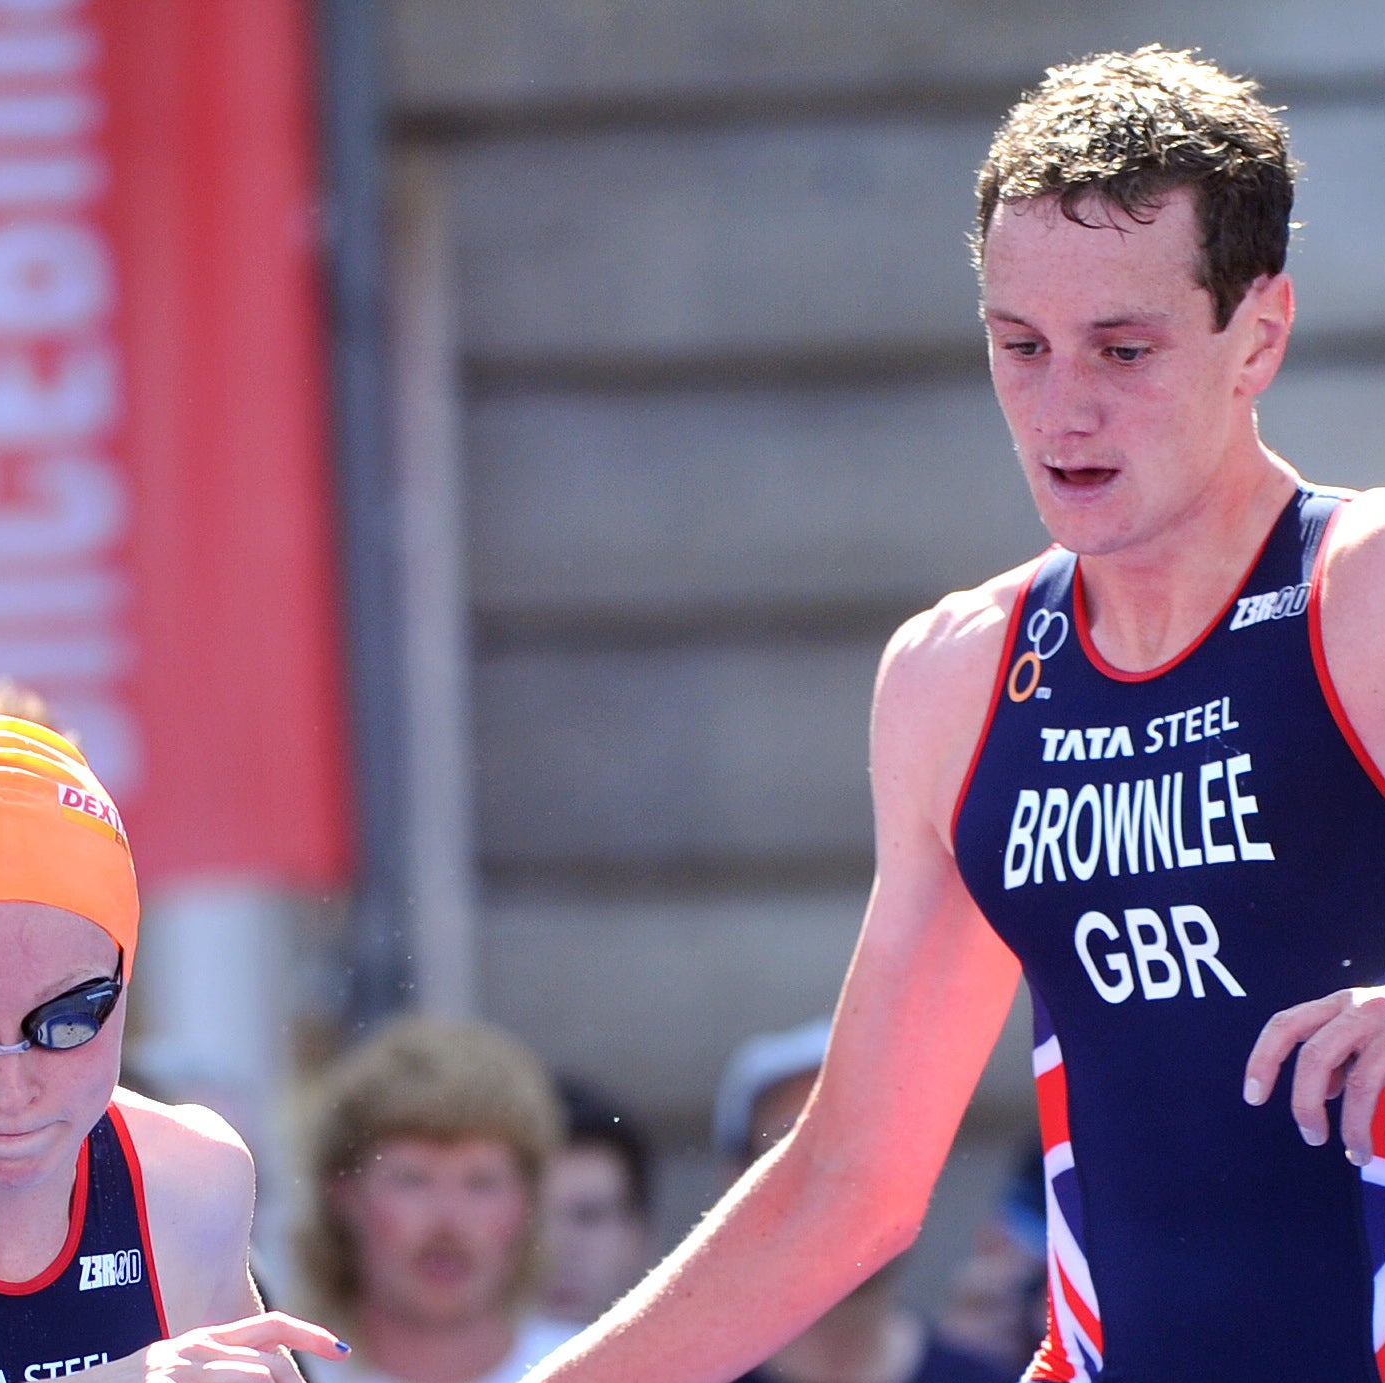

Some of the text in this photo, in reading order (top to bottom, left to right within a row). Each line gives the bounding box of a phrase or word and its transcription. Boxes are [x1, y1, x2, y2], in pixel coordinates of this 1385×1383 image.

[1040, 696, 1240, 762] TATA STEEL
[1003, 752, 1276, 890] BROWNLEE
[1074, 903, 1247, 1004] GBR
